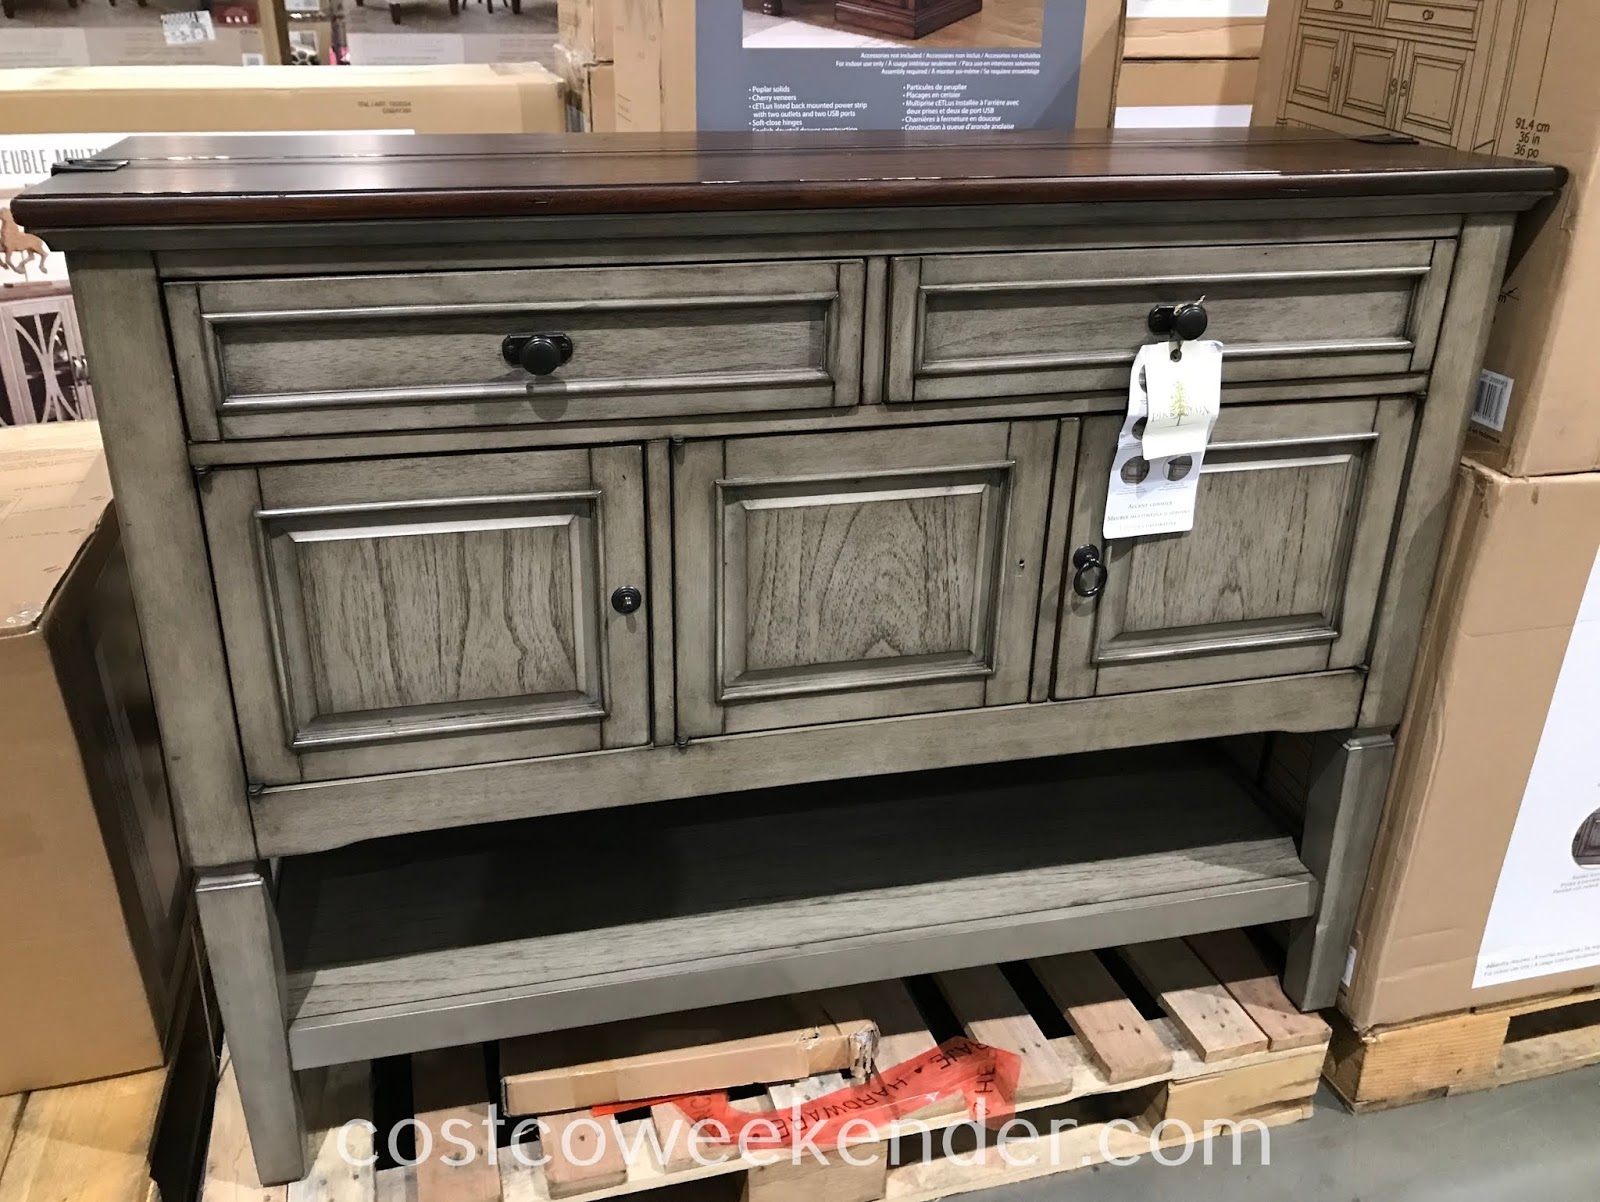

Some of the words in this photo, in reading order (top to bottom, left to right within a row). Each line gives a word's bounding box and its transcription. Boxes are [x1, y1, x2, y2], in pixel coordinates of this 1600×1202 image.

[854, 102, 868, 110] strip
[782, 119, 802, 127] hinges
[1515, 117, 1535, 130] 91.4
[1536, 123, 1550, 133] cm
[1519, 131, 1530, 143] 36
[1532, 133, 1540, 145] in
[1514, 144, 1526, 156] 36
[1527, 148, 1540, 159] po
[0, 149, 49, 175] EUBLE
[771, 1078, 908, 1140] HARDWARE
